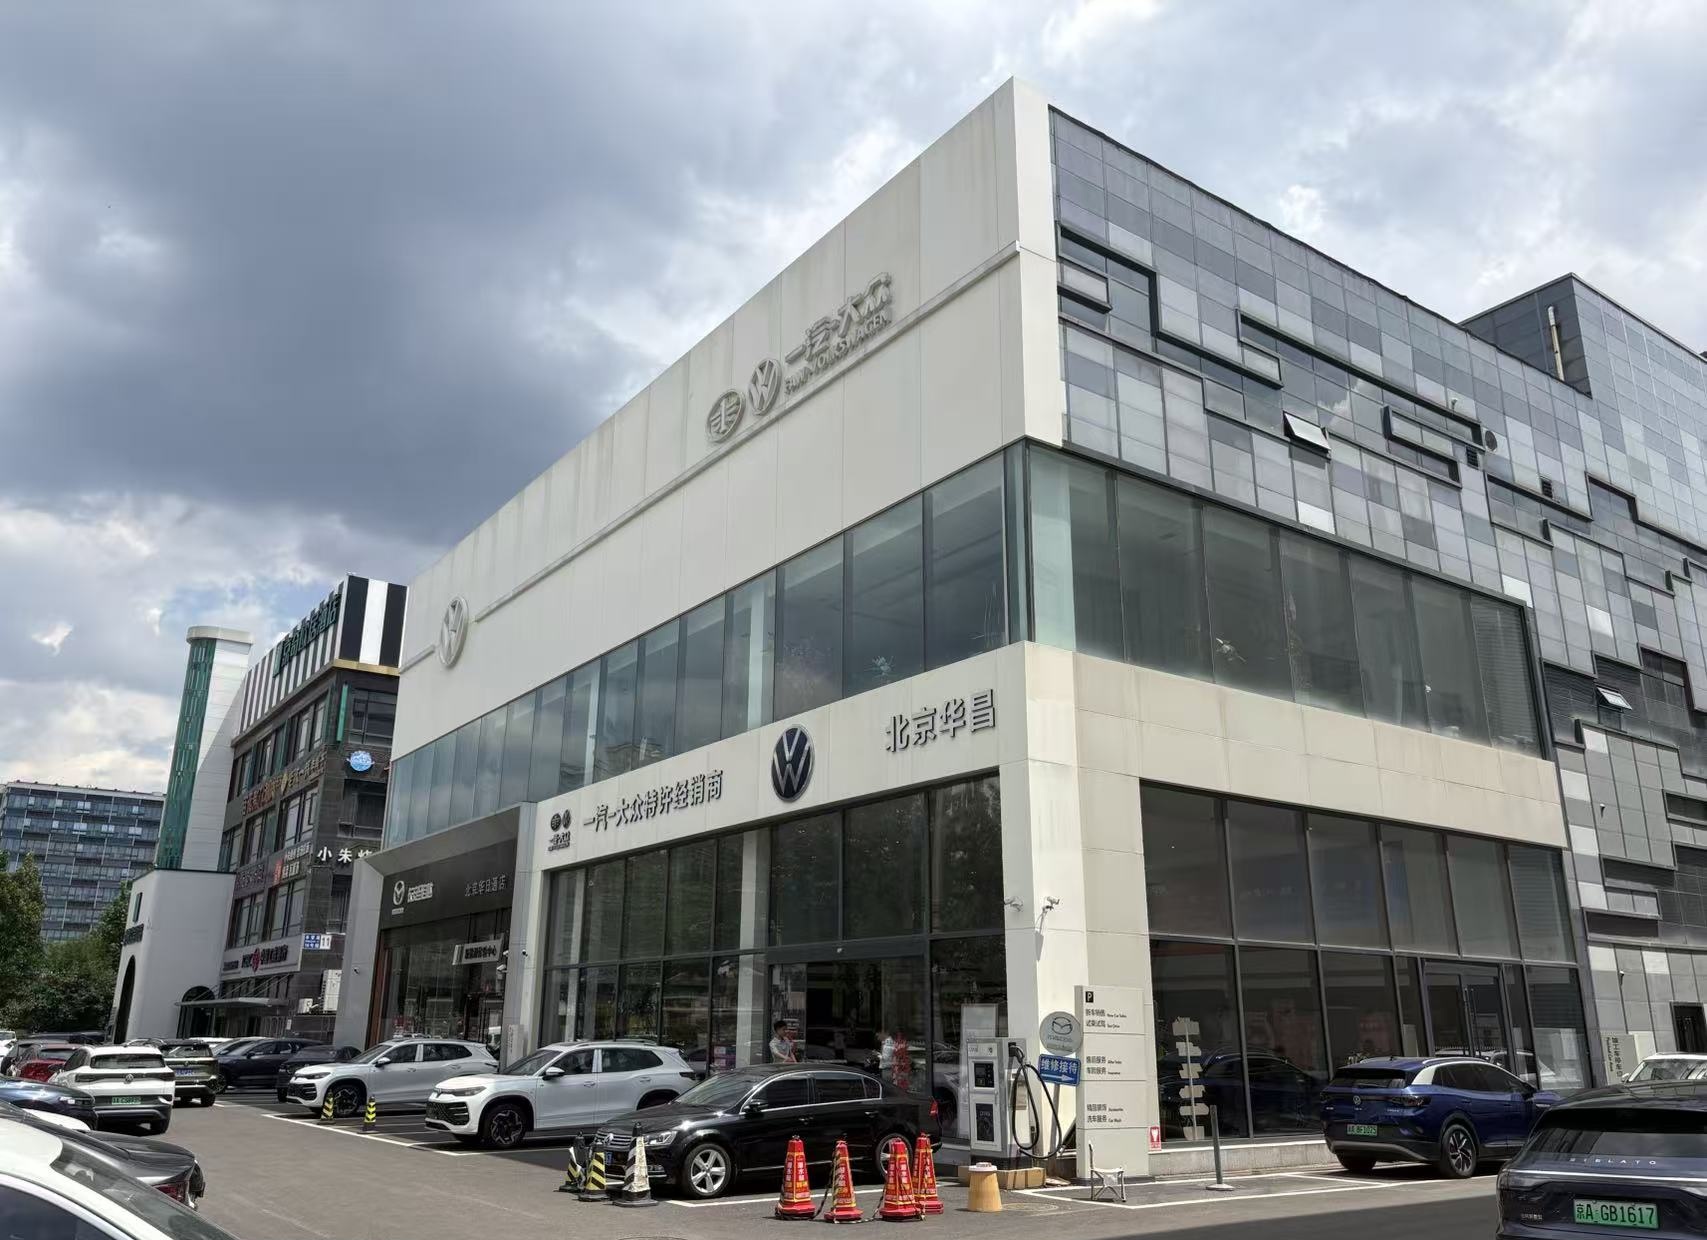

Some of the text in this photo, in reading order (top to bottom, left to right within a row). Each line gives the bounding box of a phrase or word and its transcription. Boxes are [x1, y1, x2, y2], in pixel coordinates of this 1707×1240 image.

[886, 689, 996, 752] 北京华昌
[1040, 1058, 1078, 1074] 维修接待
